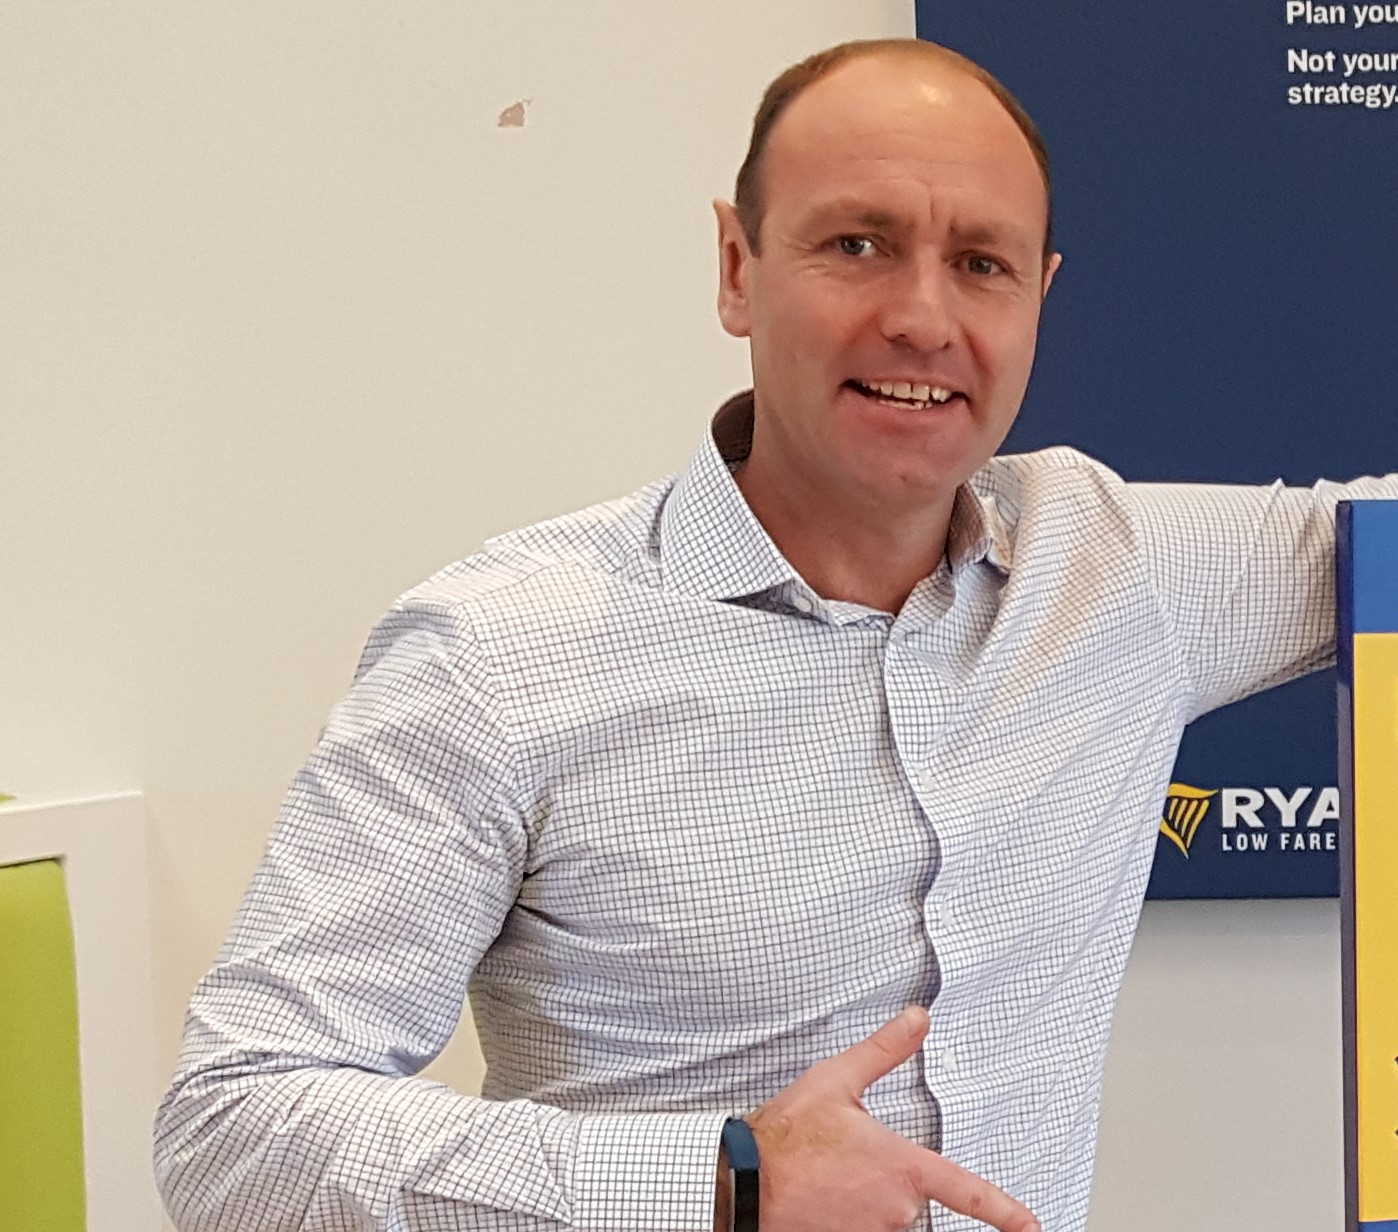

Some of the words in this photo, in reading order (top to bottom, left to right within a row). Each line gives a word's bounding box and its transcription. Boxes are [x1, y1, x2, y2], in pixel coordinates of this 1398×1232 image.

[1286, 0, 1346, 25] Plan
[1287, 48, 1336, 75] Not
[1222, 833, 1268, 851] LOW
